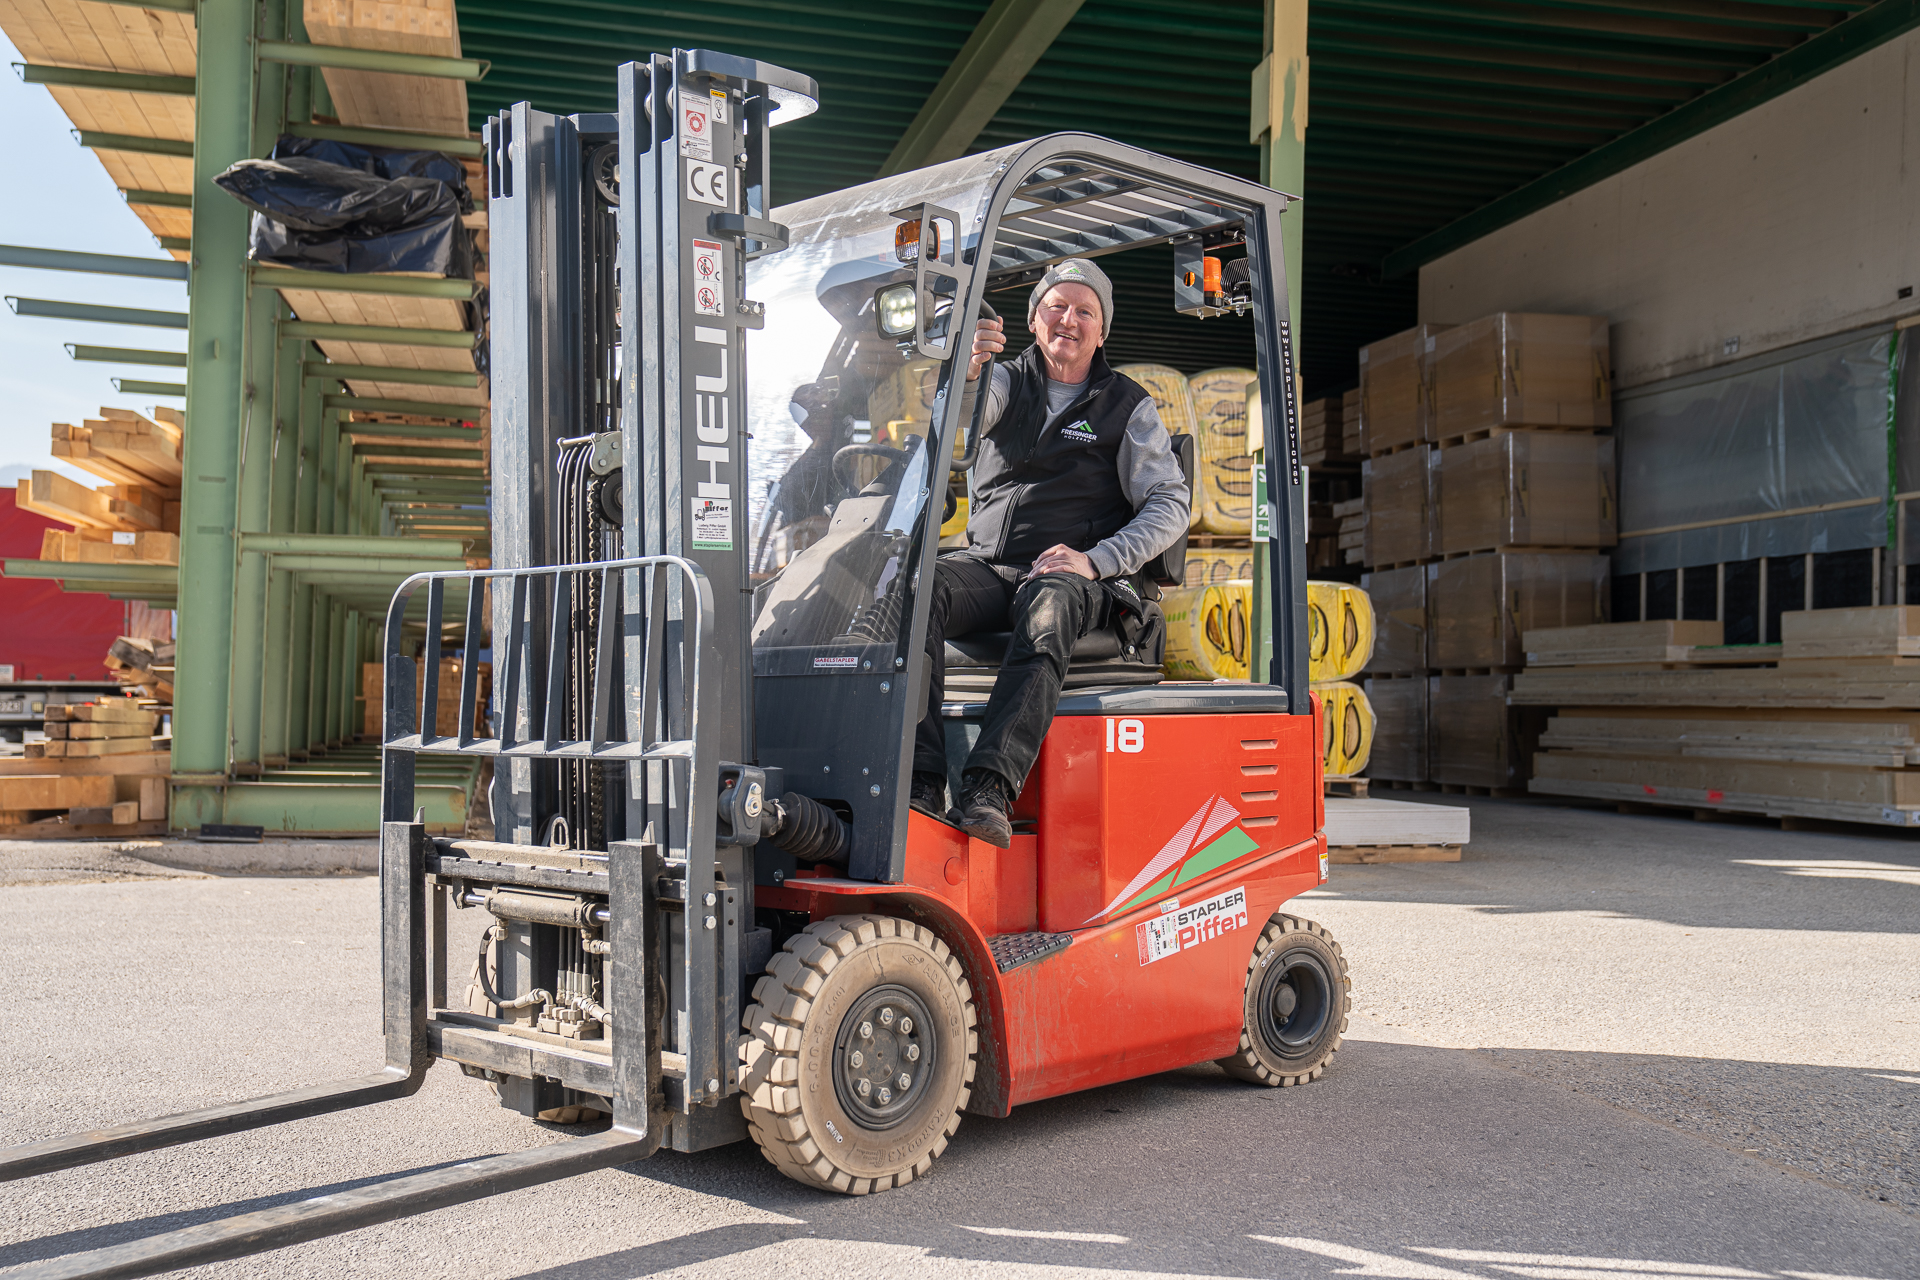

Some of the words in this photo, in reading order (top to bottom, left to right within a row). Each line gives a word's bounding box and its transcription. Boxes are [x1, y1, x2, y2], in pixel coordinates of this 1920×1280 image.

[690, 166, 724, 201] CE
[695, 325, 731, 499] HELI
[1280, 321, 1299, 485] www.staplerservice.at
[1060, 428, 1098, 441] FREISINGER
[1106, 718, 1145, 754] 18
[1177, 891, 1244, 926] STAPLER
[1177, 911, 1247, 951] Piffer
